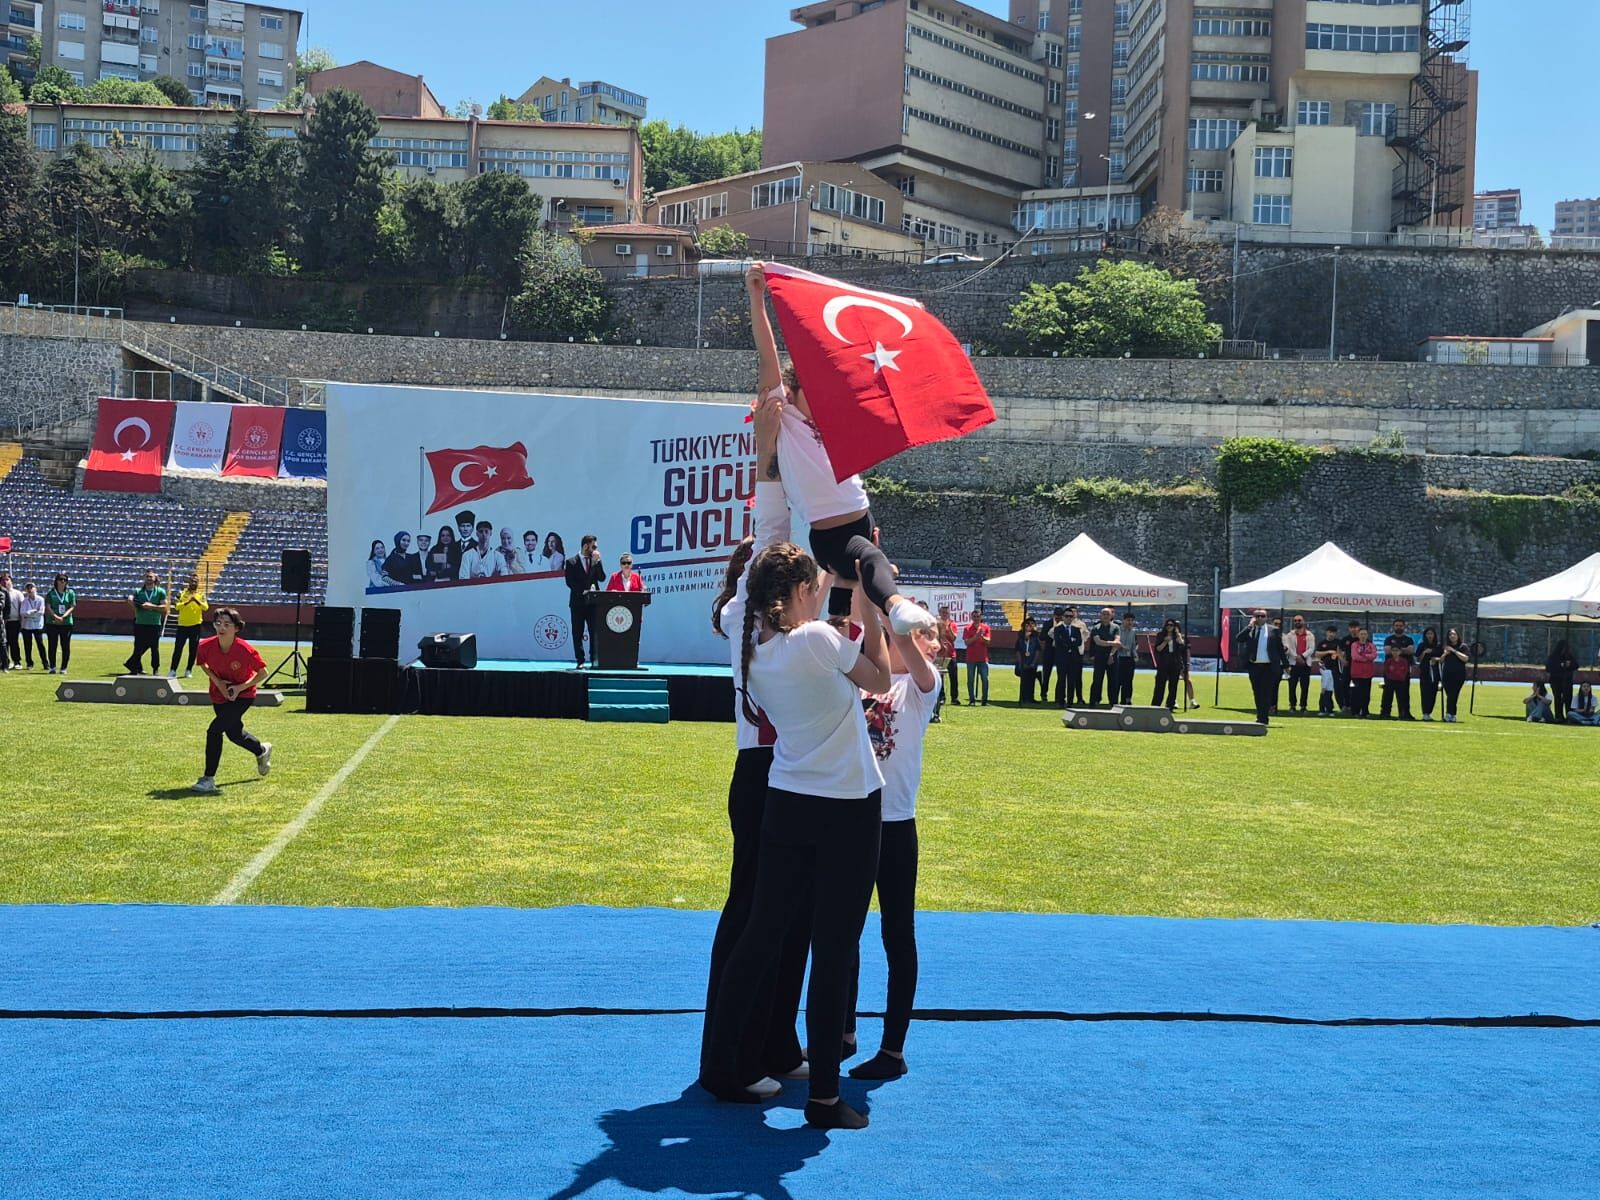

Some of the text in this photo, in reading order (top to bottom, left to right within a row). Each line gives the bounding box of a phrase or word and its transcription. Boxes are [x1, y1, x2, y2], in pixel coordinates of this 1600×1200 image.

[650, 432, 757, 464] TÜRKİYE'Nİ
[664, 461, 757, 507] GÜCÜ
[630, 506, 752, 555] GENÇLİ
[1056, 587, 1117, 598] ZONGULDAK
[1312, 596, 1373, 606] ZONGULDAK
